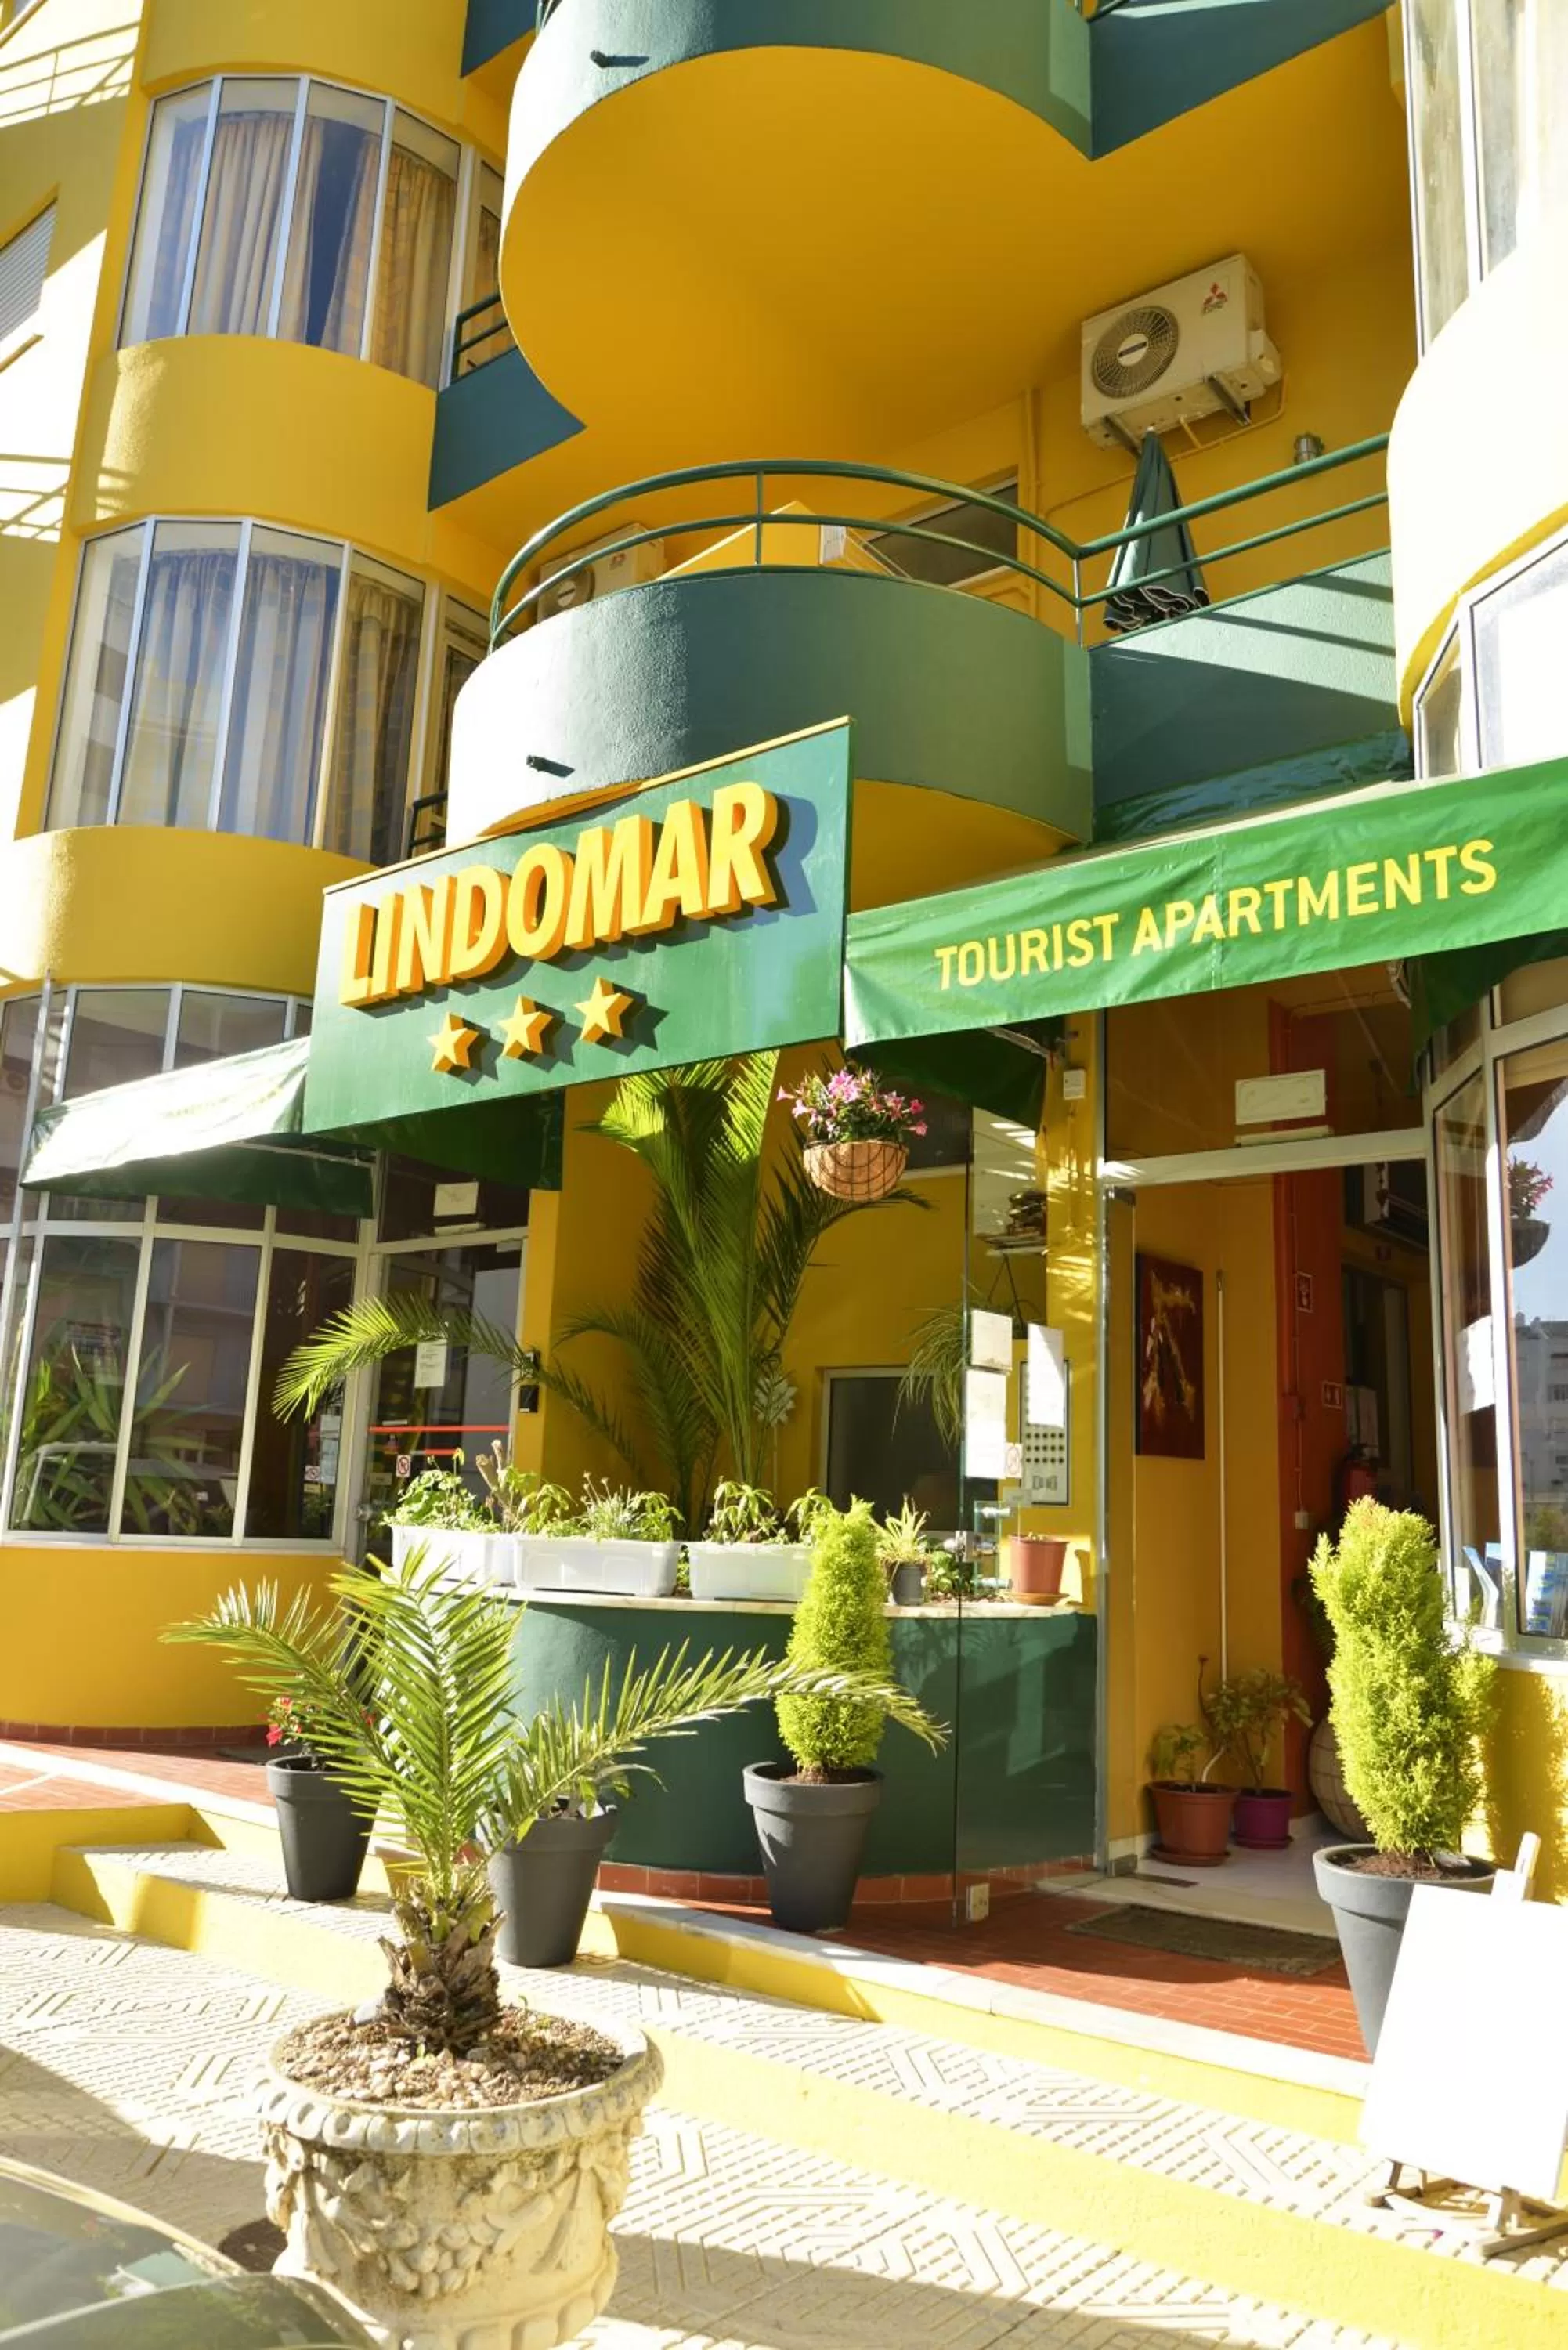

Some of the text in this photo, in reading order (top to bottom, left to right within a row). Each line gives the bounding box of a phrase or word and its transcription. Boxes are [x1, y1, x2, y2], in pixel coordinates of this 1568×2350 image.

[339, 781, 777, 1008] LINDOMAR
[934, 839, 1498, 991] TOURIST APARTMENTS
